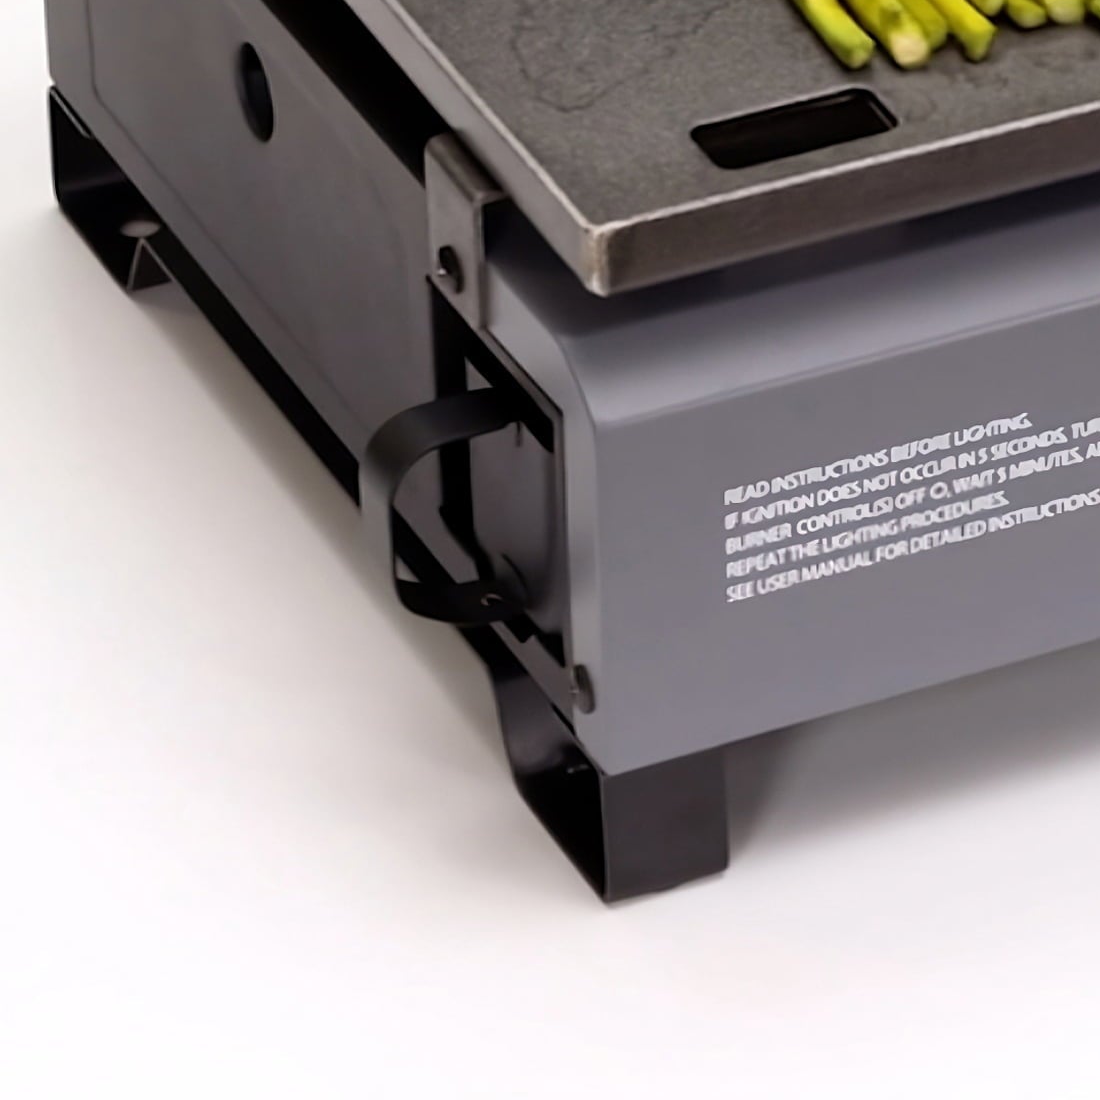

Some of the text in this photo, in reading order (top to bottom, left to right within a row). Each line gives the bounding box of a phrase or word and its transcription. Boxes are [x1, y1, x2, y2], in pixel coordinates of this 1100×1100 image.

[724, 480, 770, 505] READ
[771, 449, 889, 493] INSTRUCTIONS
[890, 432, 951, 462] BEFORE
[724, 512, 739, 530] IF
[741, 493, 815, 524] IGNITION
[816, 480, 862, 506] DOES
[862, 470, 898, 493] NOT
[900, 456, 956, 484] OCCUR
[958, 451, 976, 469] IN
[725, 523, 792, 555] BURNER
[895, 487, 926, 509] OFF
[952, 468, 995, 494] WAIT
[726, 548, 787, 578] REPEAT
[789, 539, 820, 562] THE
[822, 519, 899, 553] LIGHTING
[726, 581, 754, 602] SEE
[756, 569, 800, 595] USER
[800, 550, 874, 581] MANUAL
[875, 540, 909, 562] FOR
[910, 520, 986, 554] DETAILED
